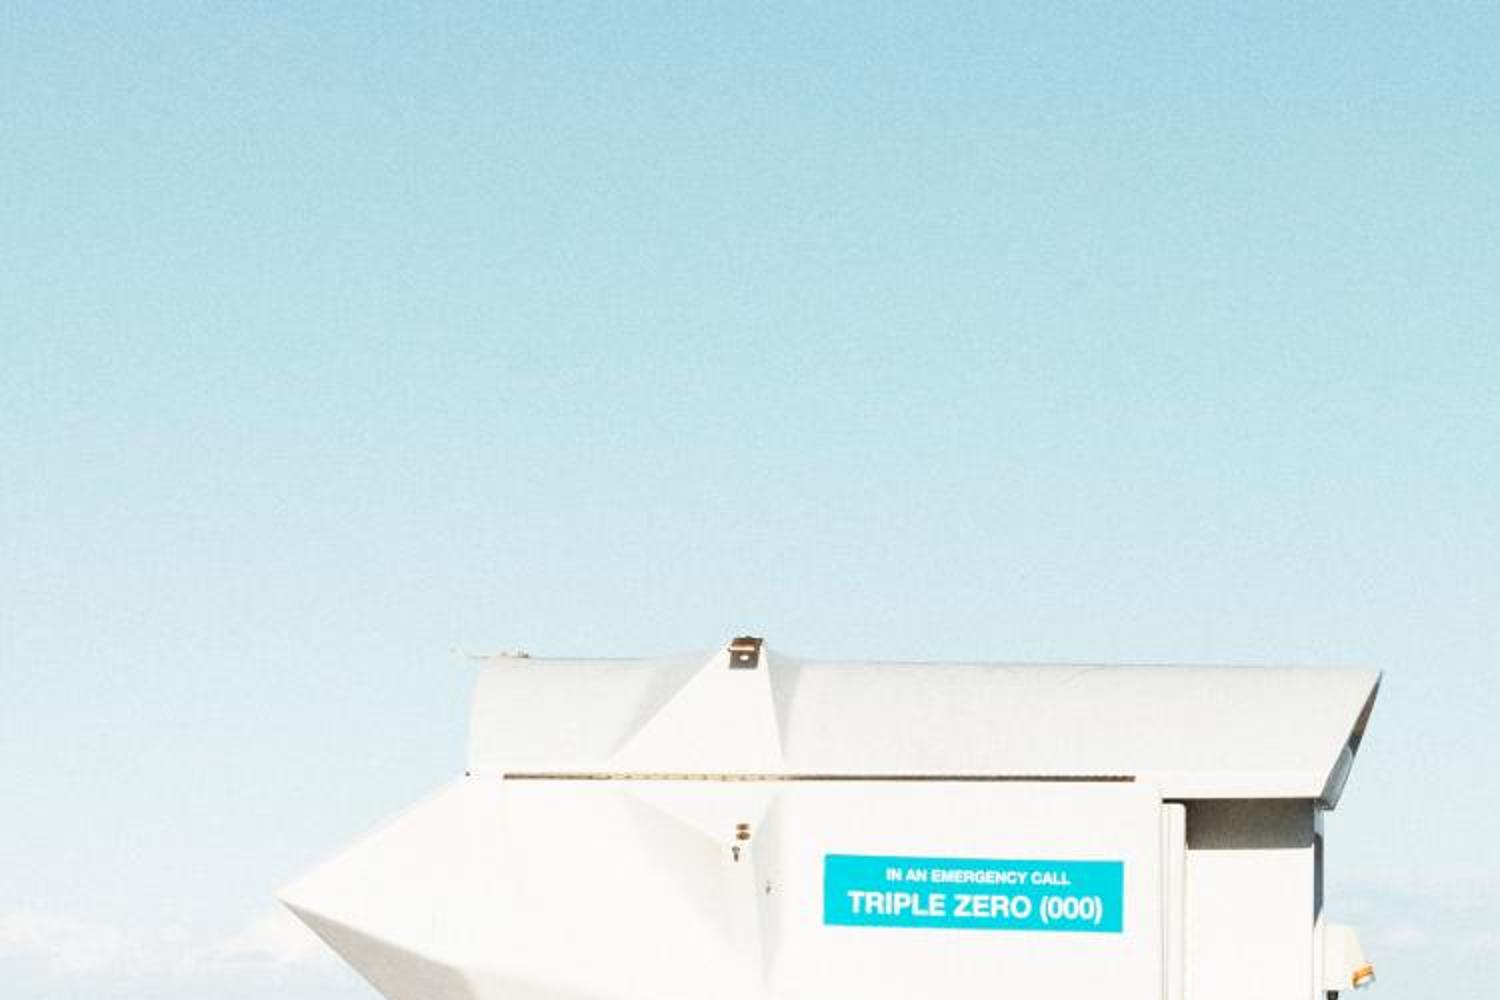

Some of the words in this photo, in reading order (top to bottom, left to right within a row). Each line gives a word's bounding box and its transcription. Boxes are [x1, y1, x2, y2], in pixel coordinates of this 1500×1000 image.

[886, 868, 902, 881] IN
[905, 869, 927, 882] AN
[931, 869, 1028, 885] EMERGENCY
[1032, 872, 1071, 885] CALL
[848, 891, 945, 916] TRIPLE
[954, 895, 1032, 918] ZERO
[1040, 895, 1103, 924] (000)
